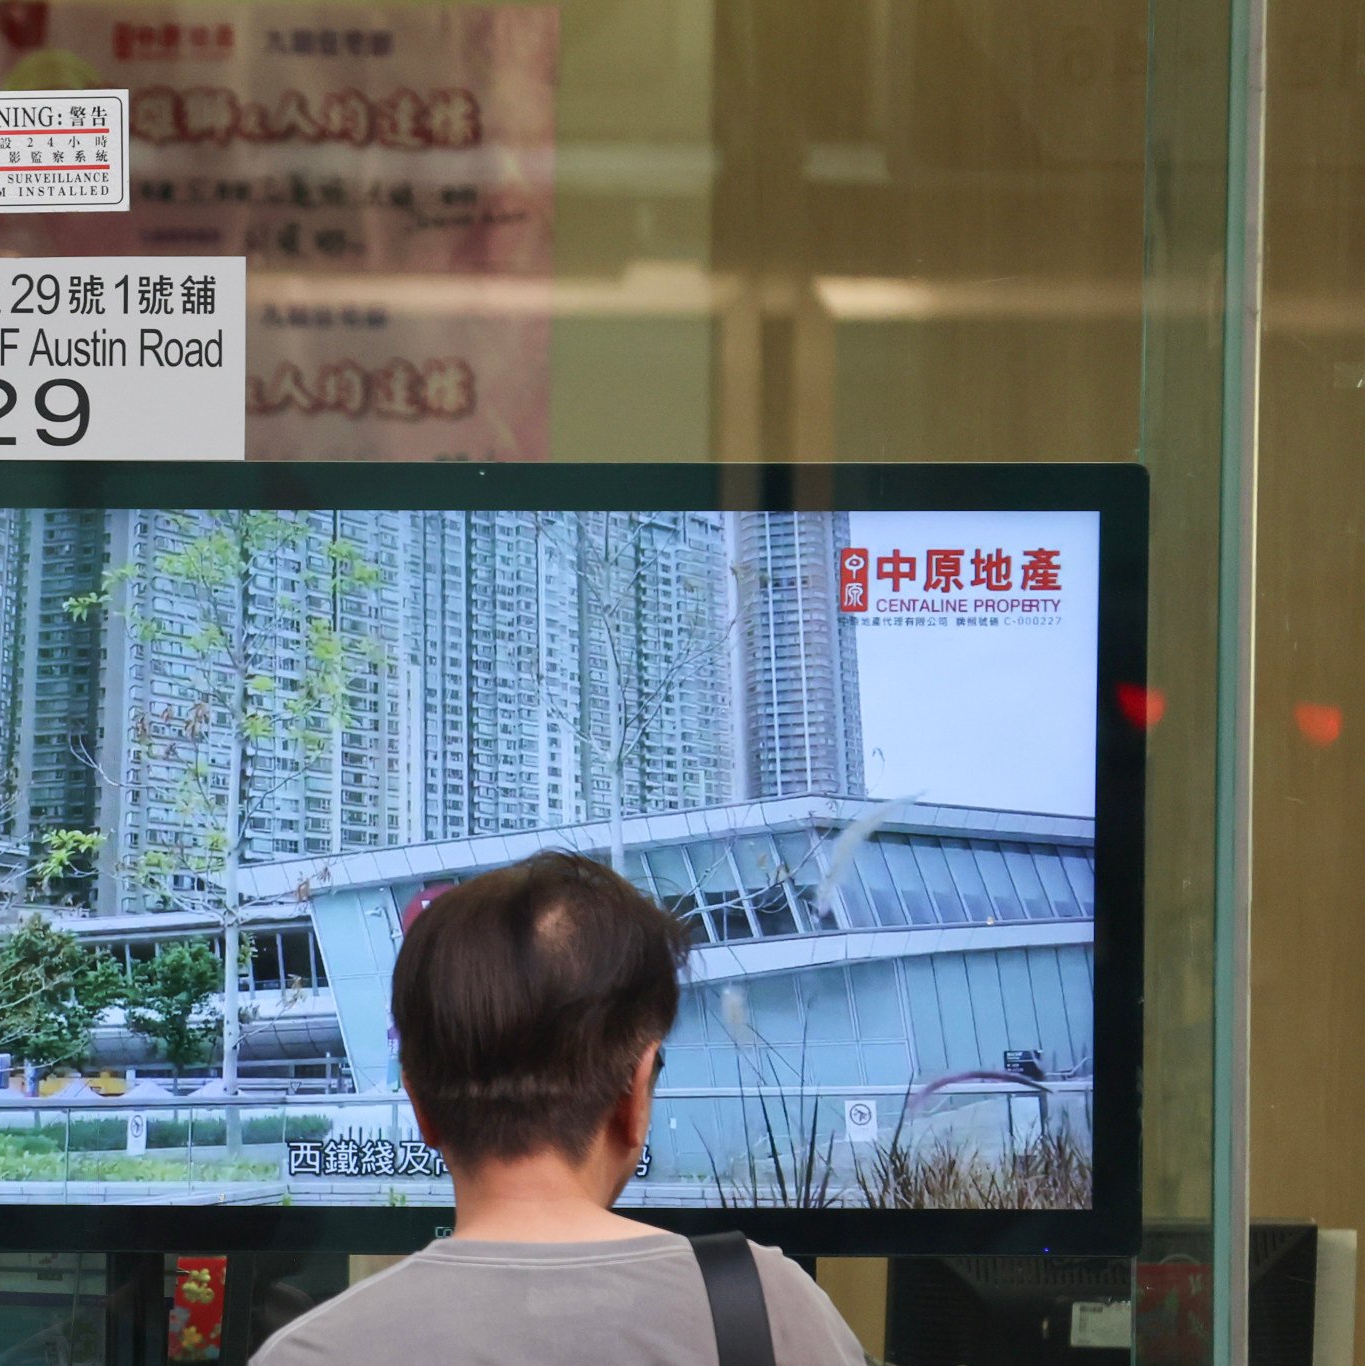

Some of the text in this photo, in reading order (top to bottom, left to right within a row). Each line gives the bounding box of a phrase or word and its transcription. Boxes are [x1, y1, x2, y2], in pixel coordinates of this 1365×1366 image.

[69, 104, 108, 128] 警告
[7, 172, 110, 184] SURVEILLANCE
[19, 184, 110, 197] INSTALLED
[29, 327, 127, 368] Austin
[139, 327, 224, 368] Road
[876, 548, 1062, 593] 中原地產
[876, 599, 1062, 613] CENTALINE PROPERTY
